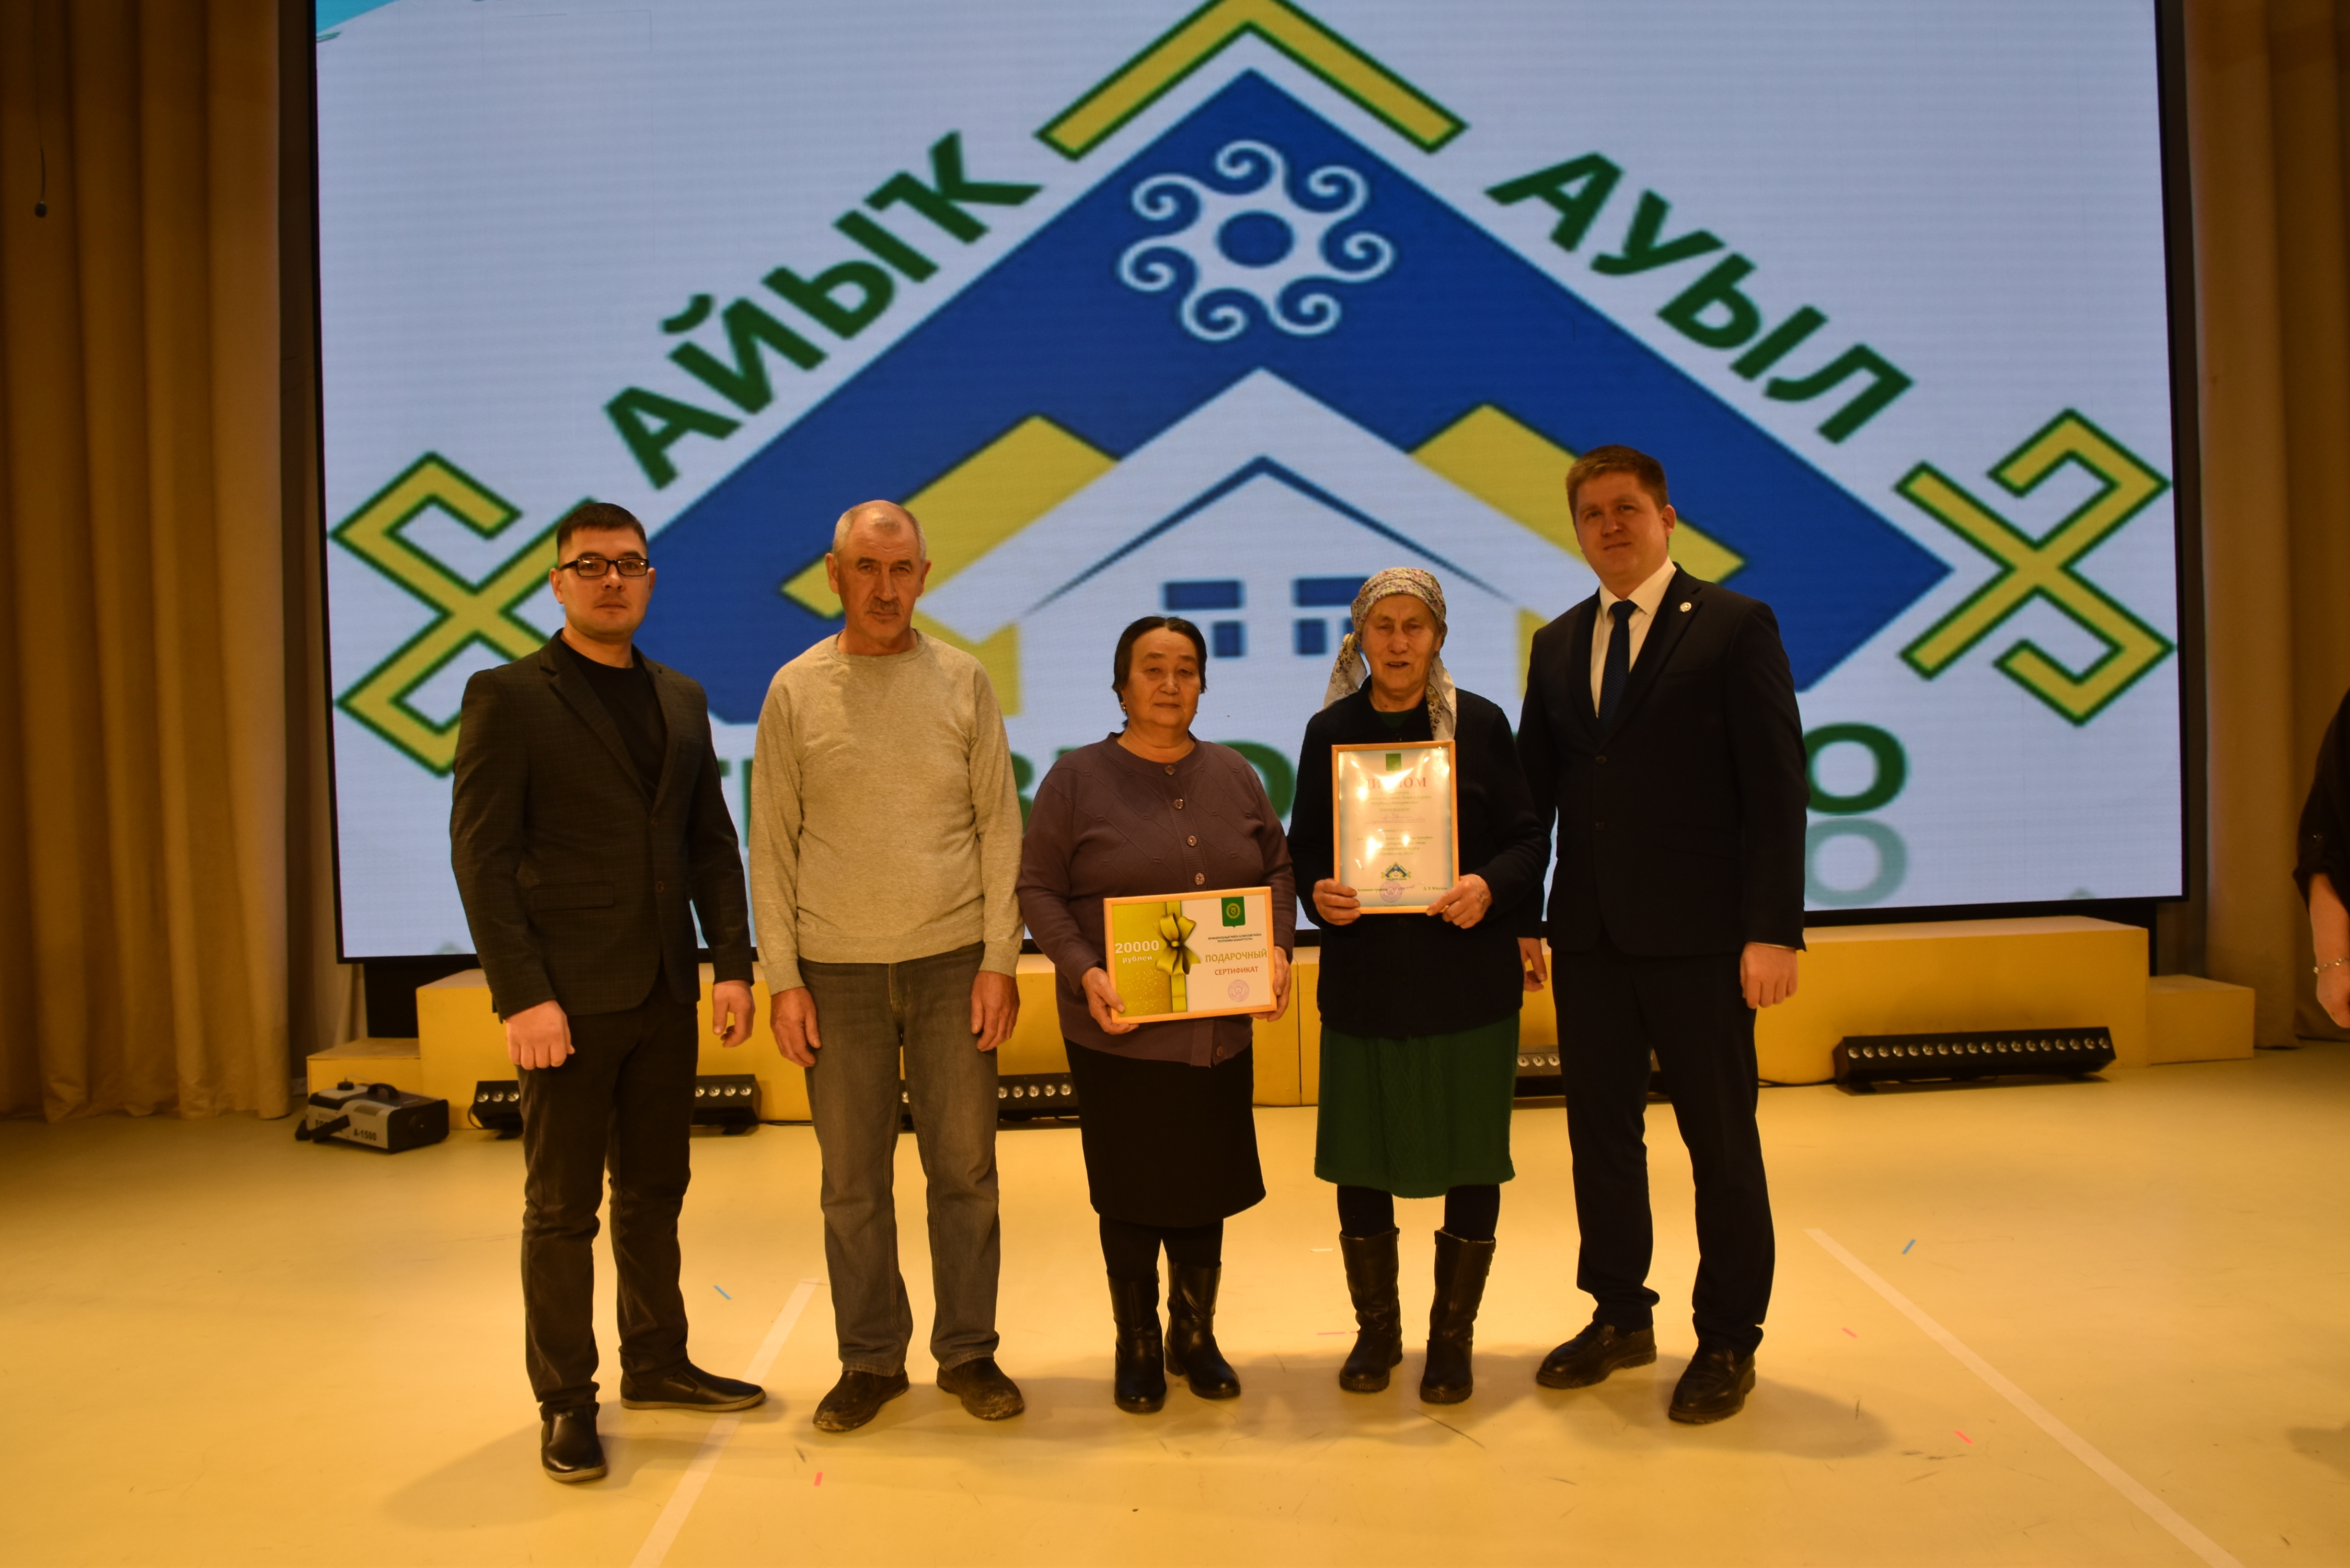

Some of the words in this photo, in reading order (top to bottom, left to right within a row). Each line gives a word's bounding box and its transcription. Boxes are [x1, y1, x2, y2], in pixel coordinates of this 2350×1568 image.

[1483, 152, 1916, 444] АУЫЛ
[1115, 940, 1160, 954] 20000
[1122, 950, 1153, 964] рублей
[1205, 948, 1268, 963] ПОДАРОЧНЫЙ
[1215, 966, 1259, 976] СЕРТИФИКАТ
[353, 1128, 377, 1141] A-1500
